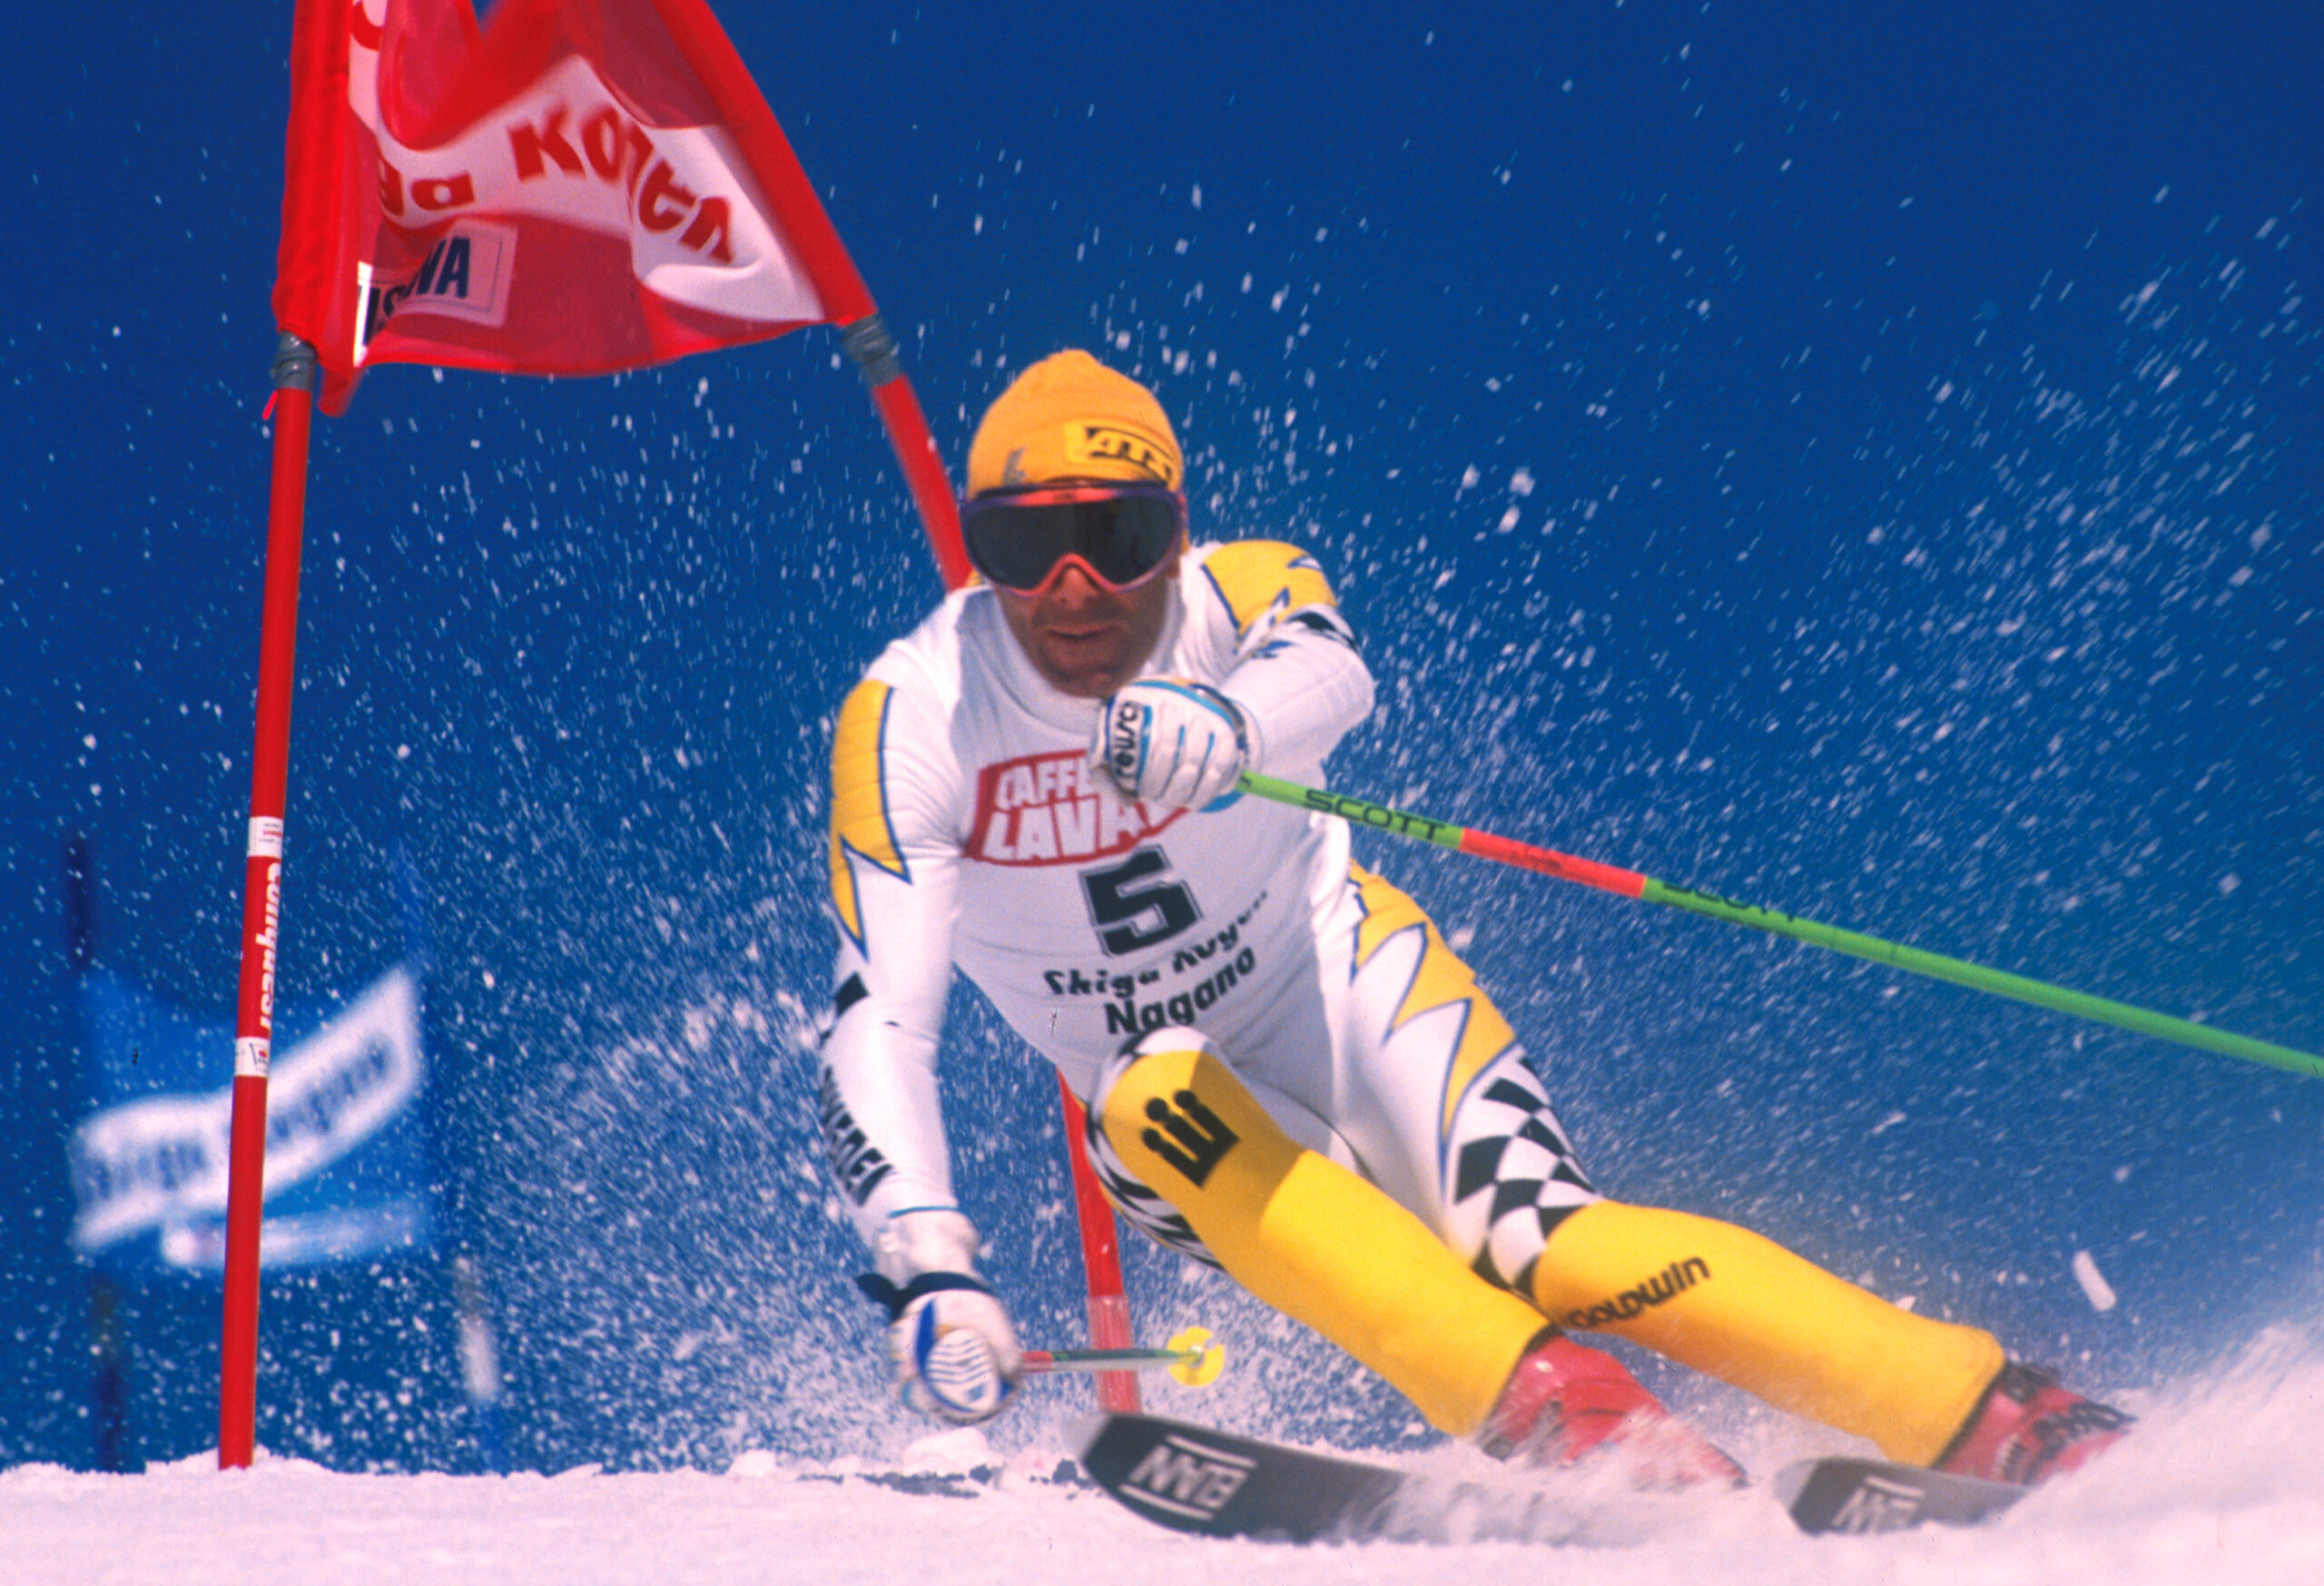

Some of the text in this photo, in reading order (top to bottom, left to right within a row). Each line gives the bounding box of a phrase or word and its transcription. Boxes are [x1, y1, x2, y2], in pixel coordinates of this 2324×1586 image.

[1304, 788, 1445, 841] SCOTT
[1078, 844, 1204, 958] 5
[1104, 946, 1255, 1035] Nagano
